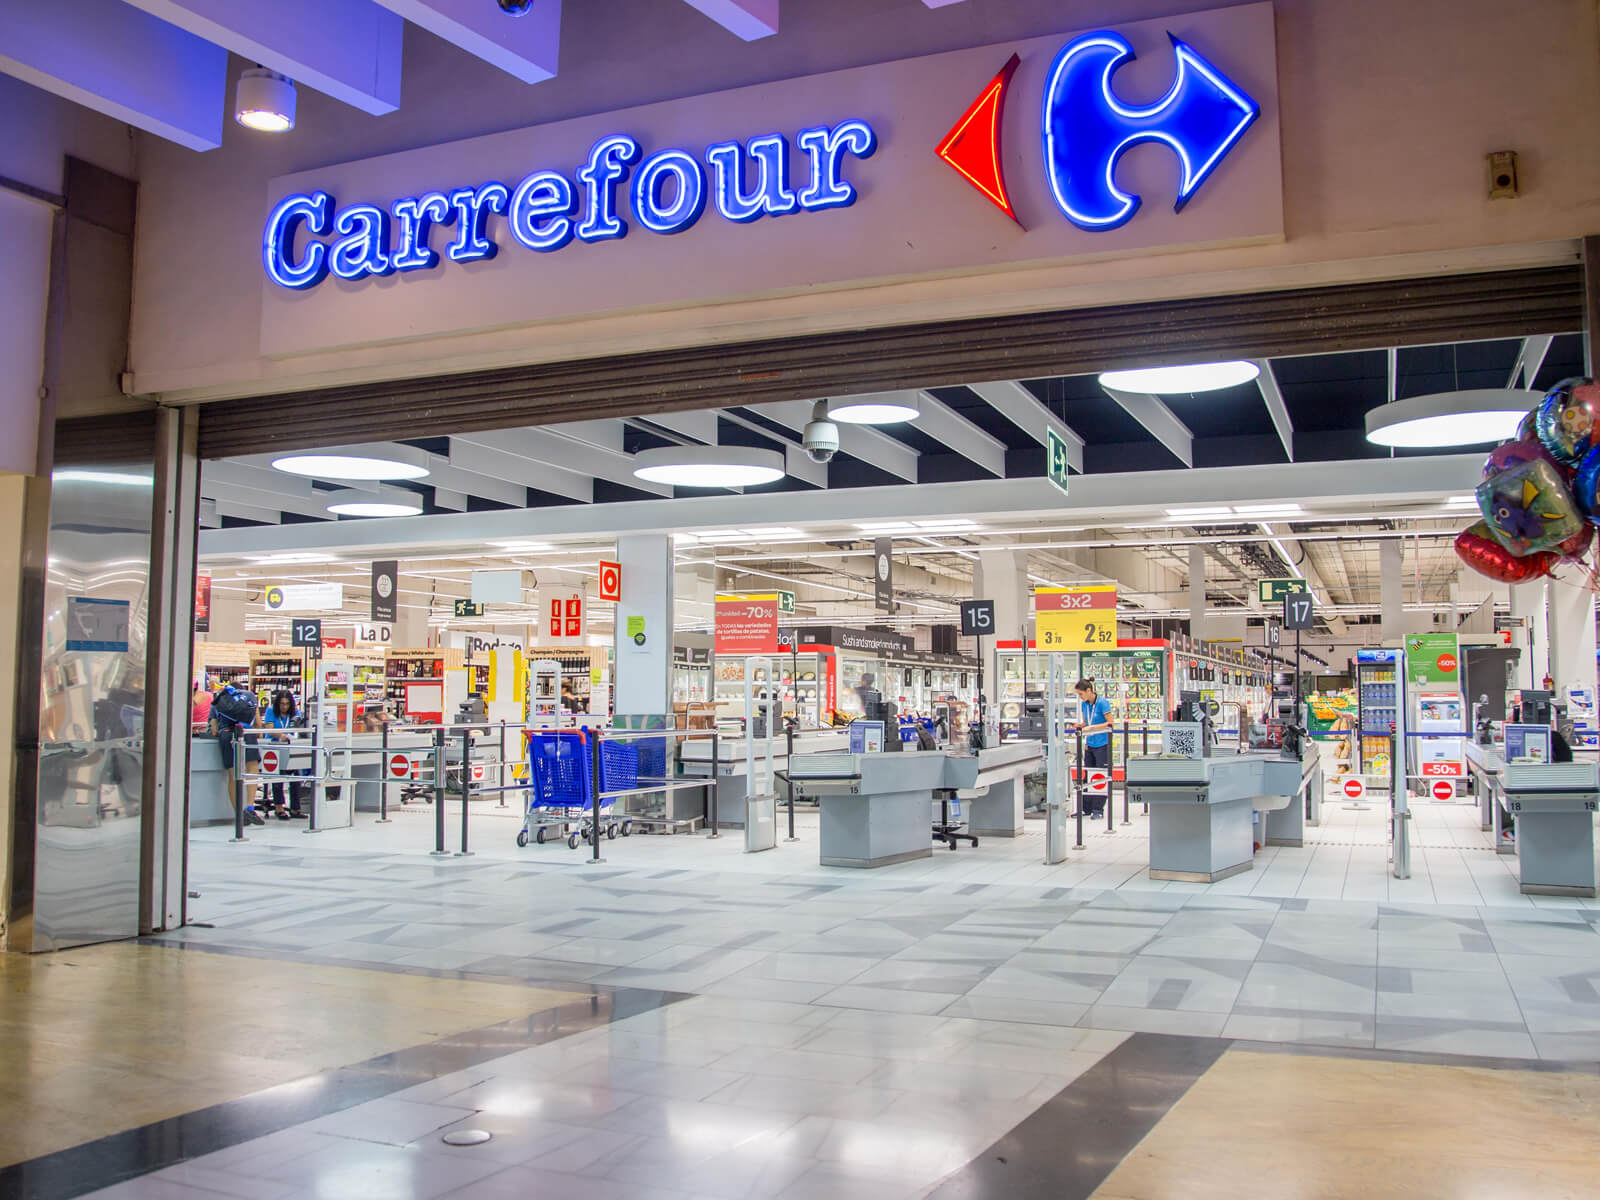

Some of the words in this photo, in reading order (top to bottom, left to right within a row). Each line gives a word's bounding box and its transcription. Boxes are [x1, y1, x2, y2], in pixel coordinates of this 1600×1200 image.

[262, 119, 877, 290] Carrefour
[1060, 594, 1092, 608] 3x2
[742, 606, 773, 618] -70%
[967, 608, 990, 628] 15
[1291, 602, 1309, 622] 17
[296, 624, 317, 641] 12
[361, 624, 376, 641] La
[1045, 632, 1053, 644] 3
[1084, 624, 1096, 643] 2
[1098, 631, 1112, 642] 52
[1270, 627, 1279, 643] 16
[1427, 764, 1457, 774] -50%
[850, 786, 858, 794] 15
[1132, 794, 1142, 802] 16
[1196, 794, 1206, 802] 17
[1511, 802, 1521, 811] 18
[1584, 801, 1596, 810] 19
